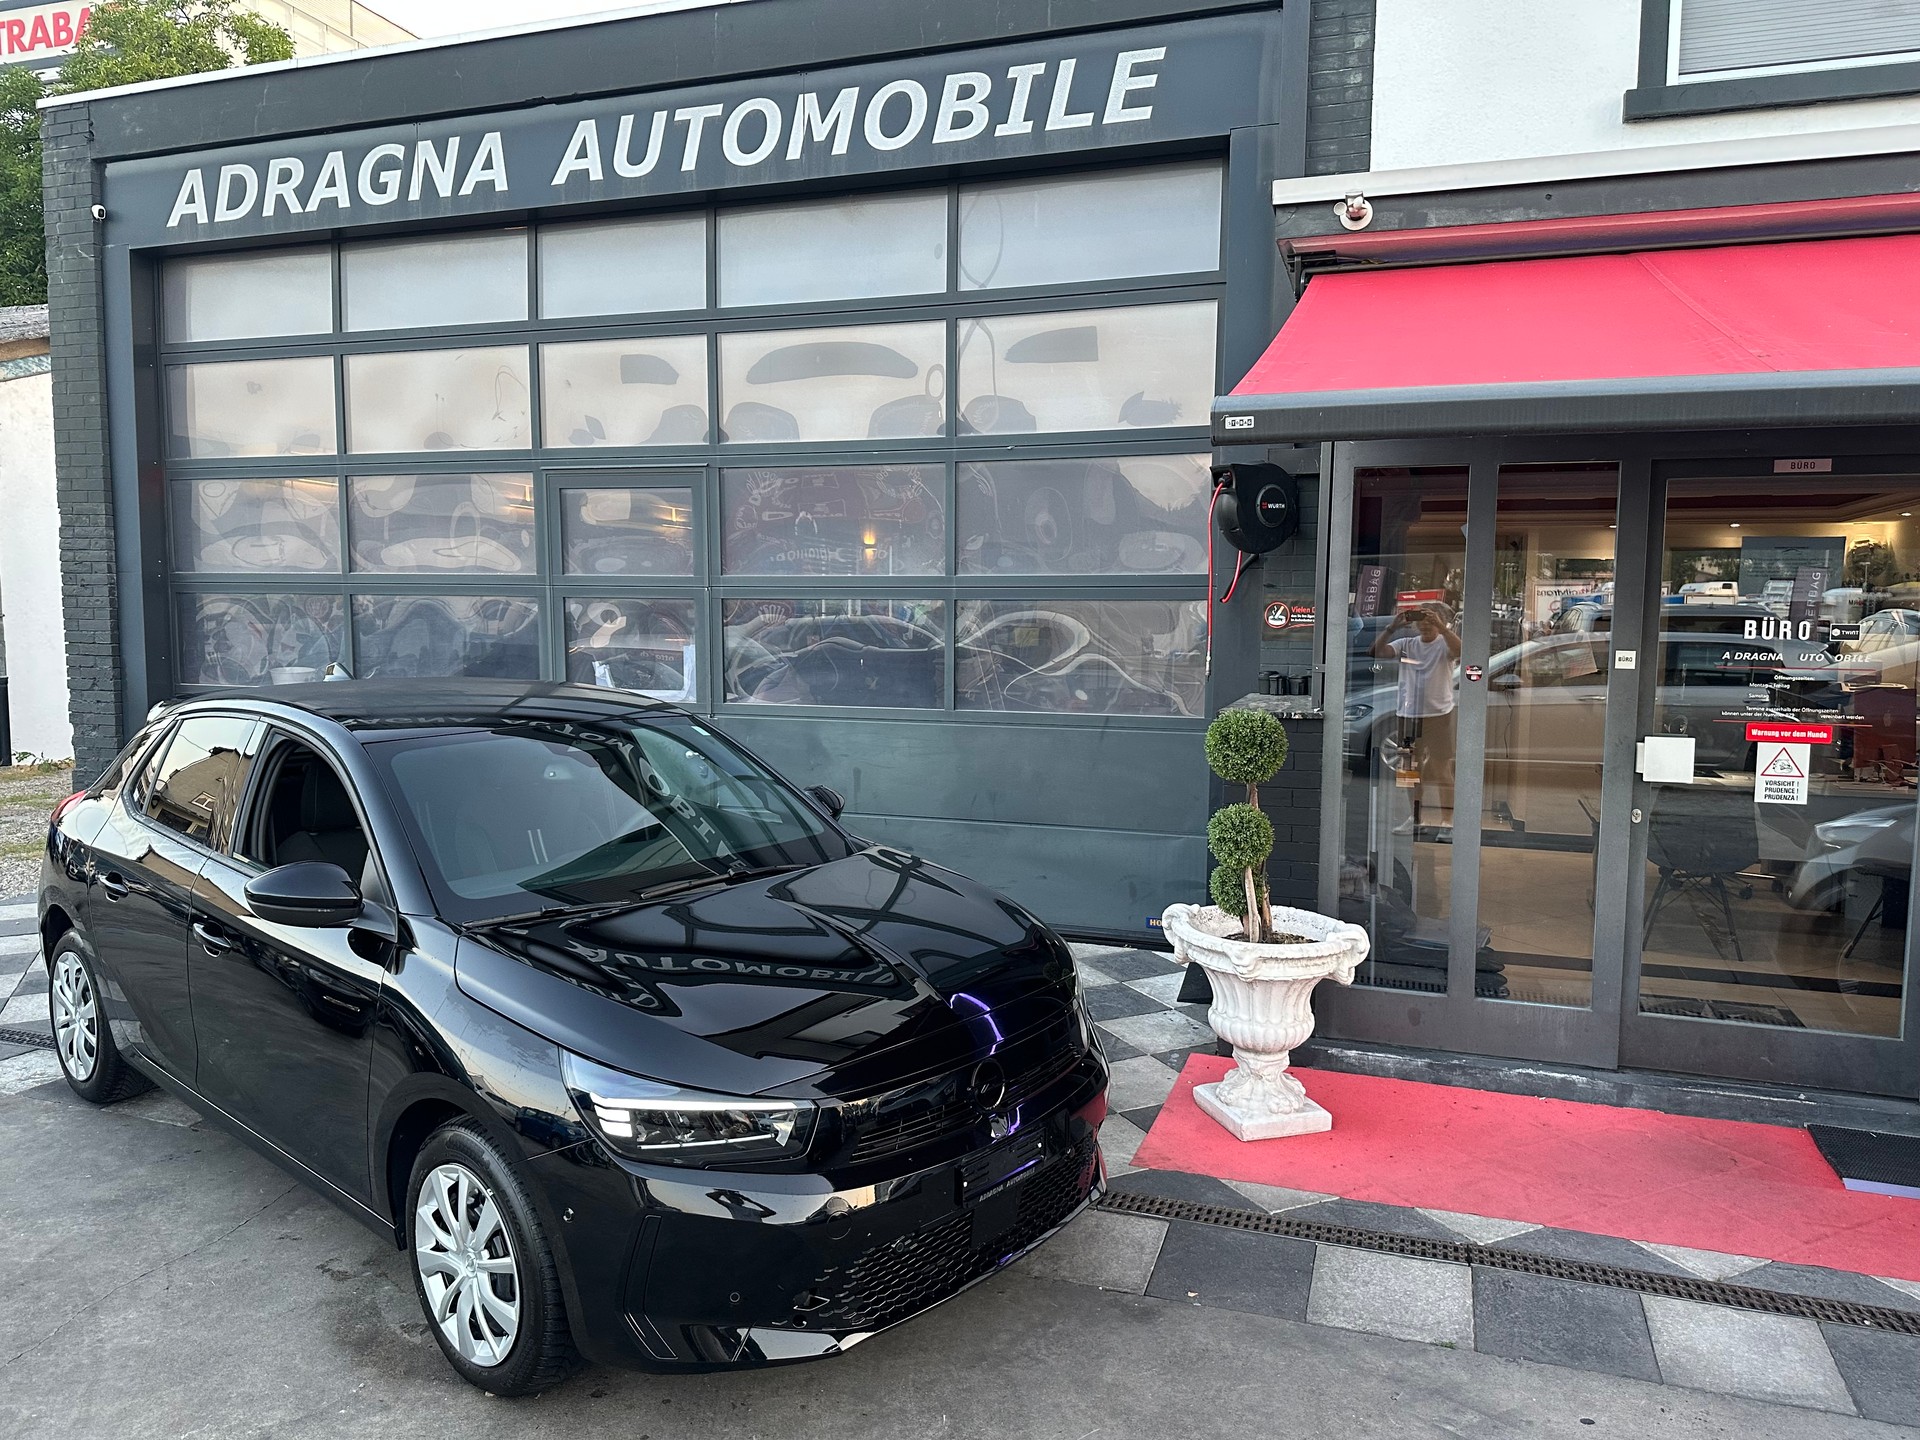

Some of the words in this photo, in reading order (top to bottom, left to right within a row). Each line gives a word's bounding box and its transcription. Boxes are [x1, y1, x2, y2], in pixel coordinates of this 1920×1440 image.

[166, 131, 509, 228] ADRAGNA
[551, 46, 1168, 186] AUTOMOBILE
[1790, 461, 1816, 470] BÜRO
[1743, 616, 1811, 640] BÜRO
[1751, 728, 1780, 738] Warnung
